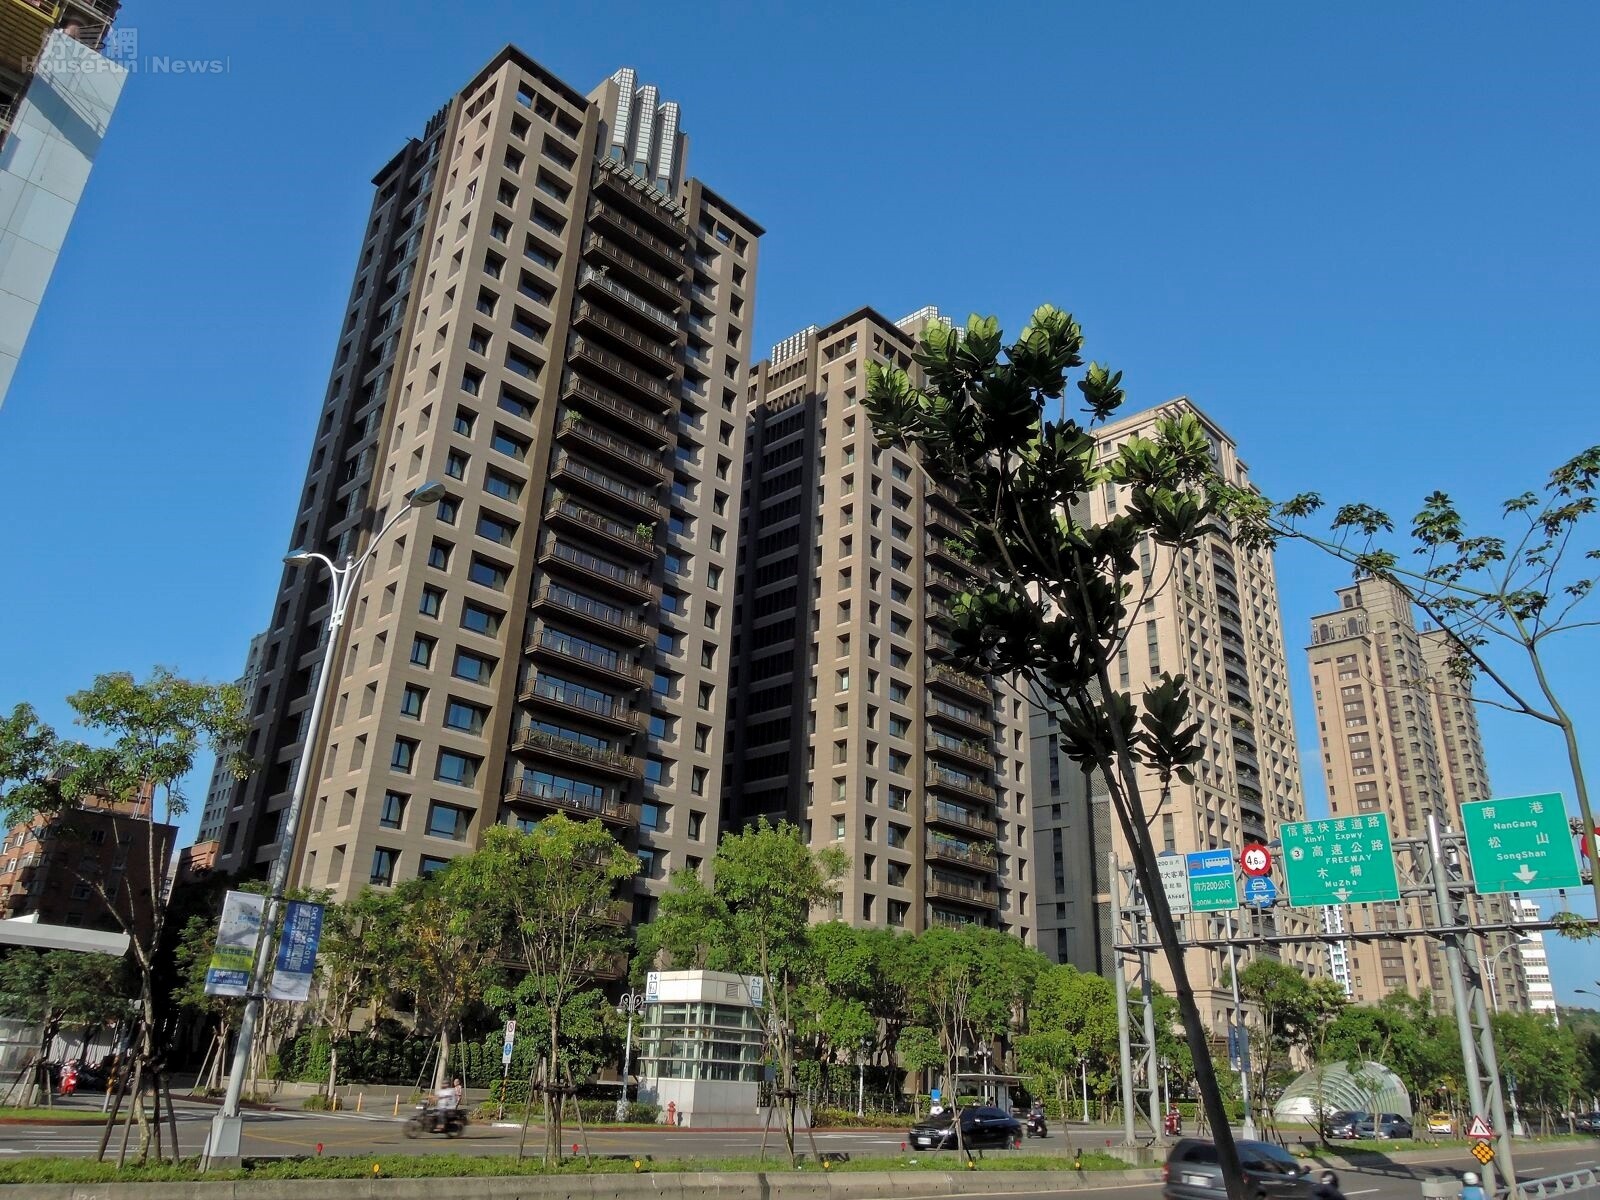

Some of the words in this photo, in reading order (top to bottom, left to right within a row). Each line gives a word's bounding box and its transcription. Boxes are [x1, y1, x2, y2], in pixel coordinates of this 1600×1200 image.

[1482, 801, 1544, 819] 南港
[1287, 816, 1380, 837] 信義快速道路
[1493, 820, 1538, 831] NanGang
[1488, 832, 1550, 849] 松山
[1312, 840, 1383, 857] 高速公路
[1497, 850, 1547, 861] SongShan
[1326, 854, 1372, 865] FREEWAY
[1317, 865, 1362, 879] 木柵
[1325, 879, 1358, 888] MuZha
